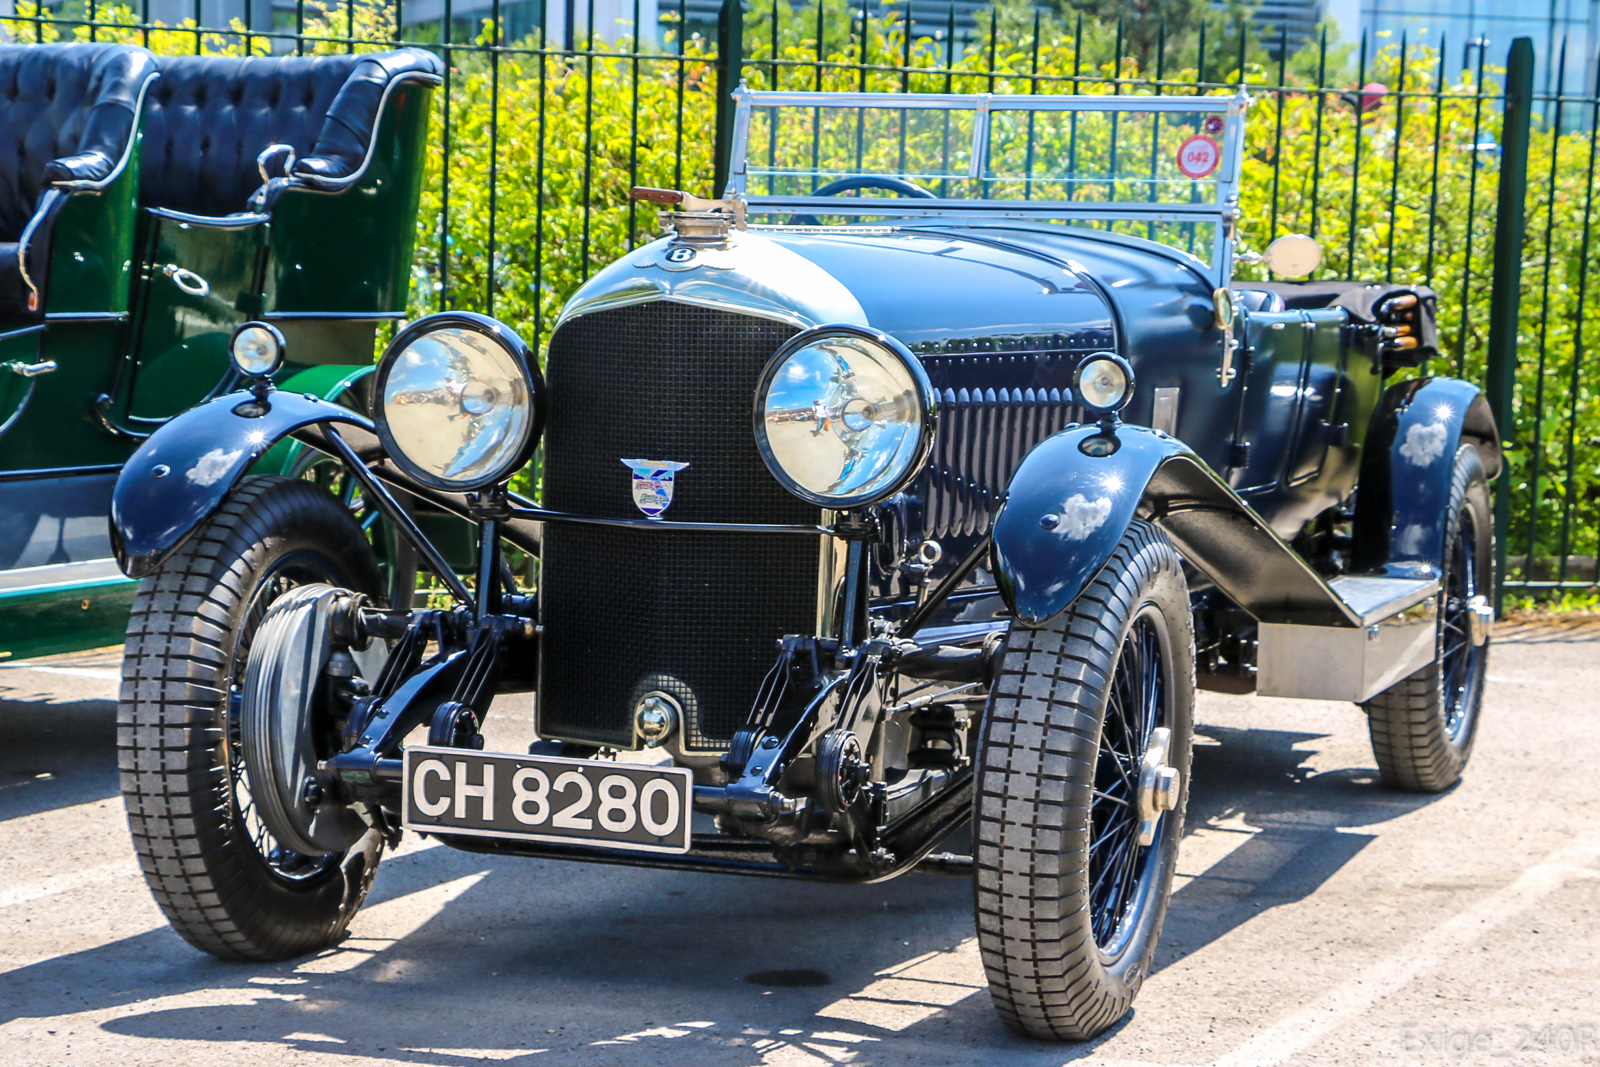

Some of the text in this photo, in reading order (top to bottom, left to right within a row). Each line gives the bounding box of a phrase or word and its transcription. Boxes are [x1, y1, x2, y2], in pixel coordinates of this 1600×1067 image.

[1187, 151, 1210, 163] 042
[670, 248, 692, 262] B
[413, 759, 680, 837] CH 8280
